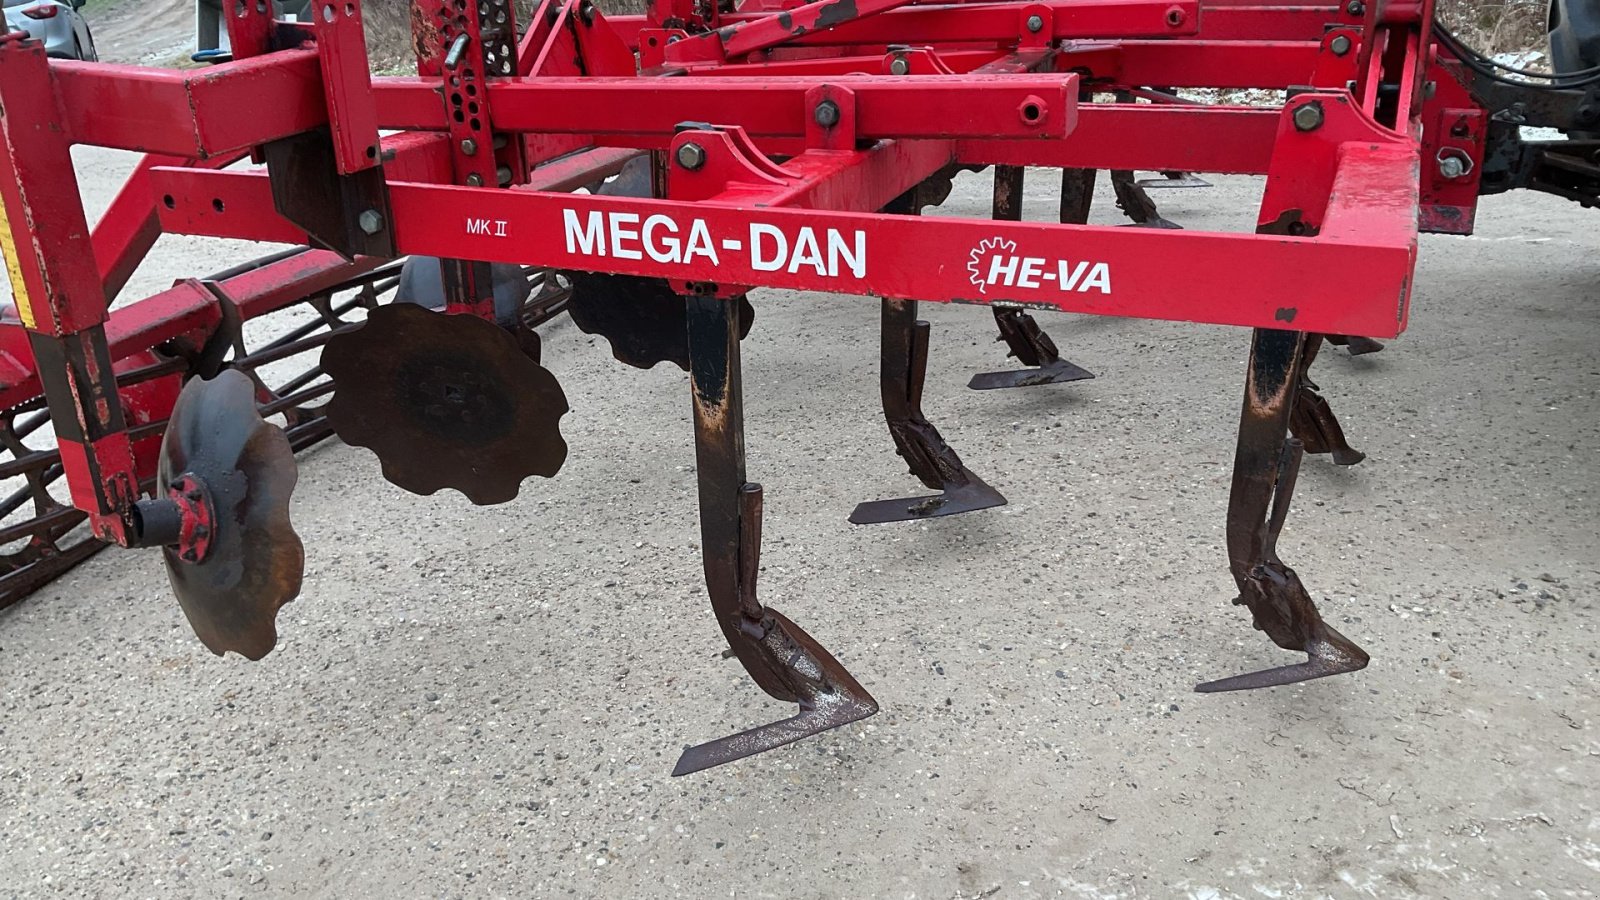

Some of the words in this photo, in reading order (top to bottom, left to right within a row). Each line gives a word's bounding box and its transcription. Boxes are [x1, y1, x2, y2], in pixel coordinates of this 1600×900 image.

[466, 218, 492, 235] MK
[563, 208, 866, 279] MEGA-DAN
[986, 255, 1112, 294] HE-VA
